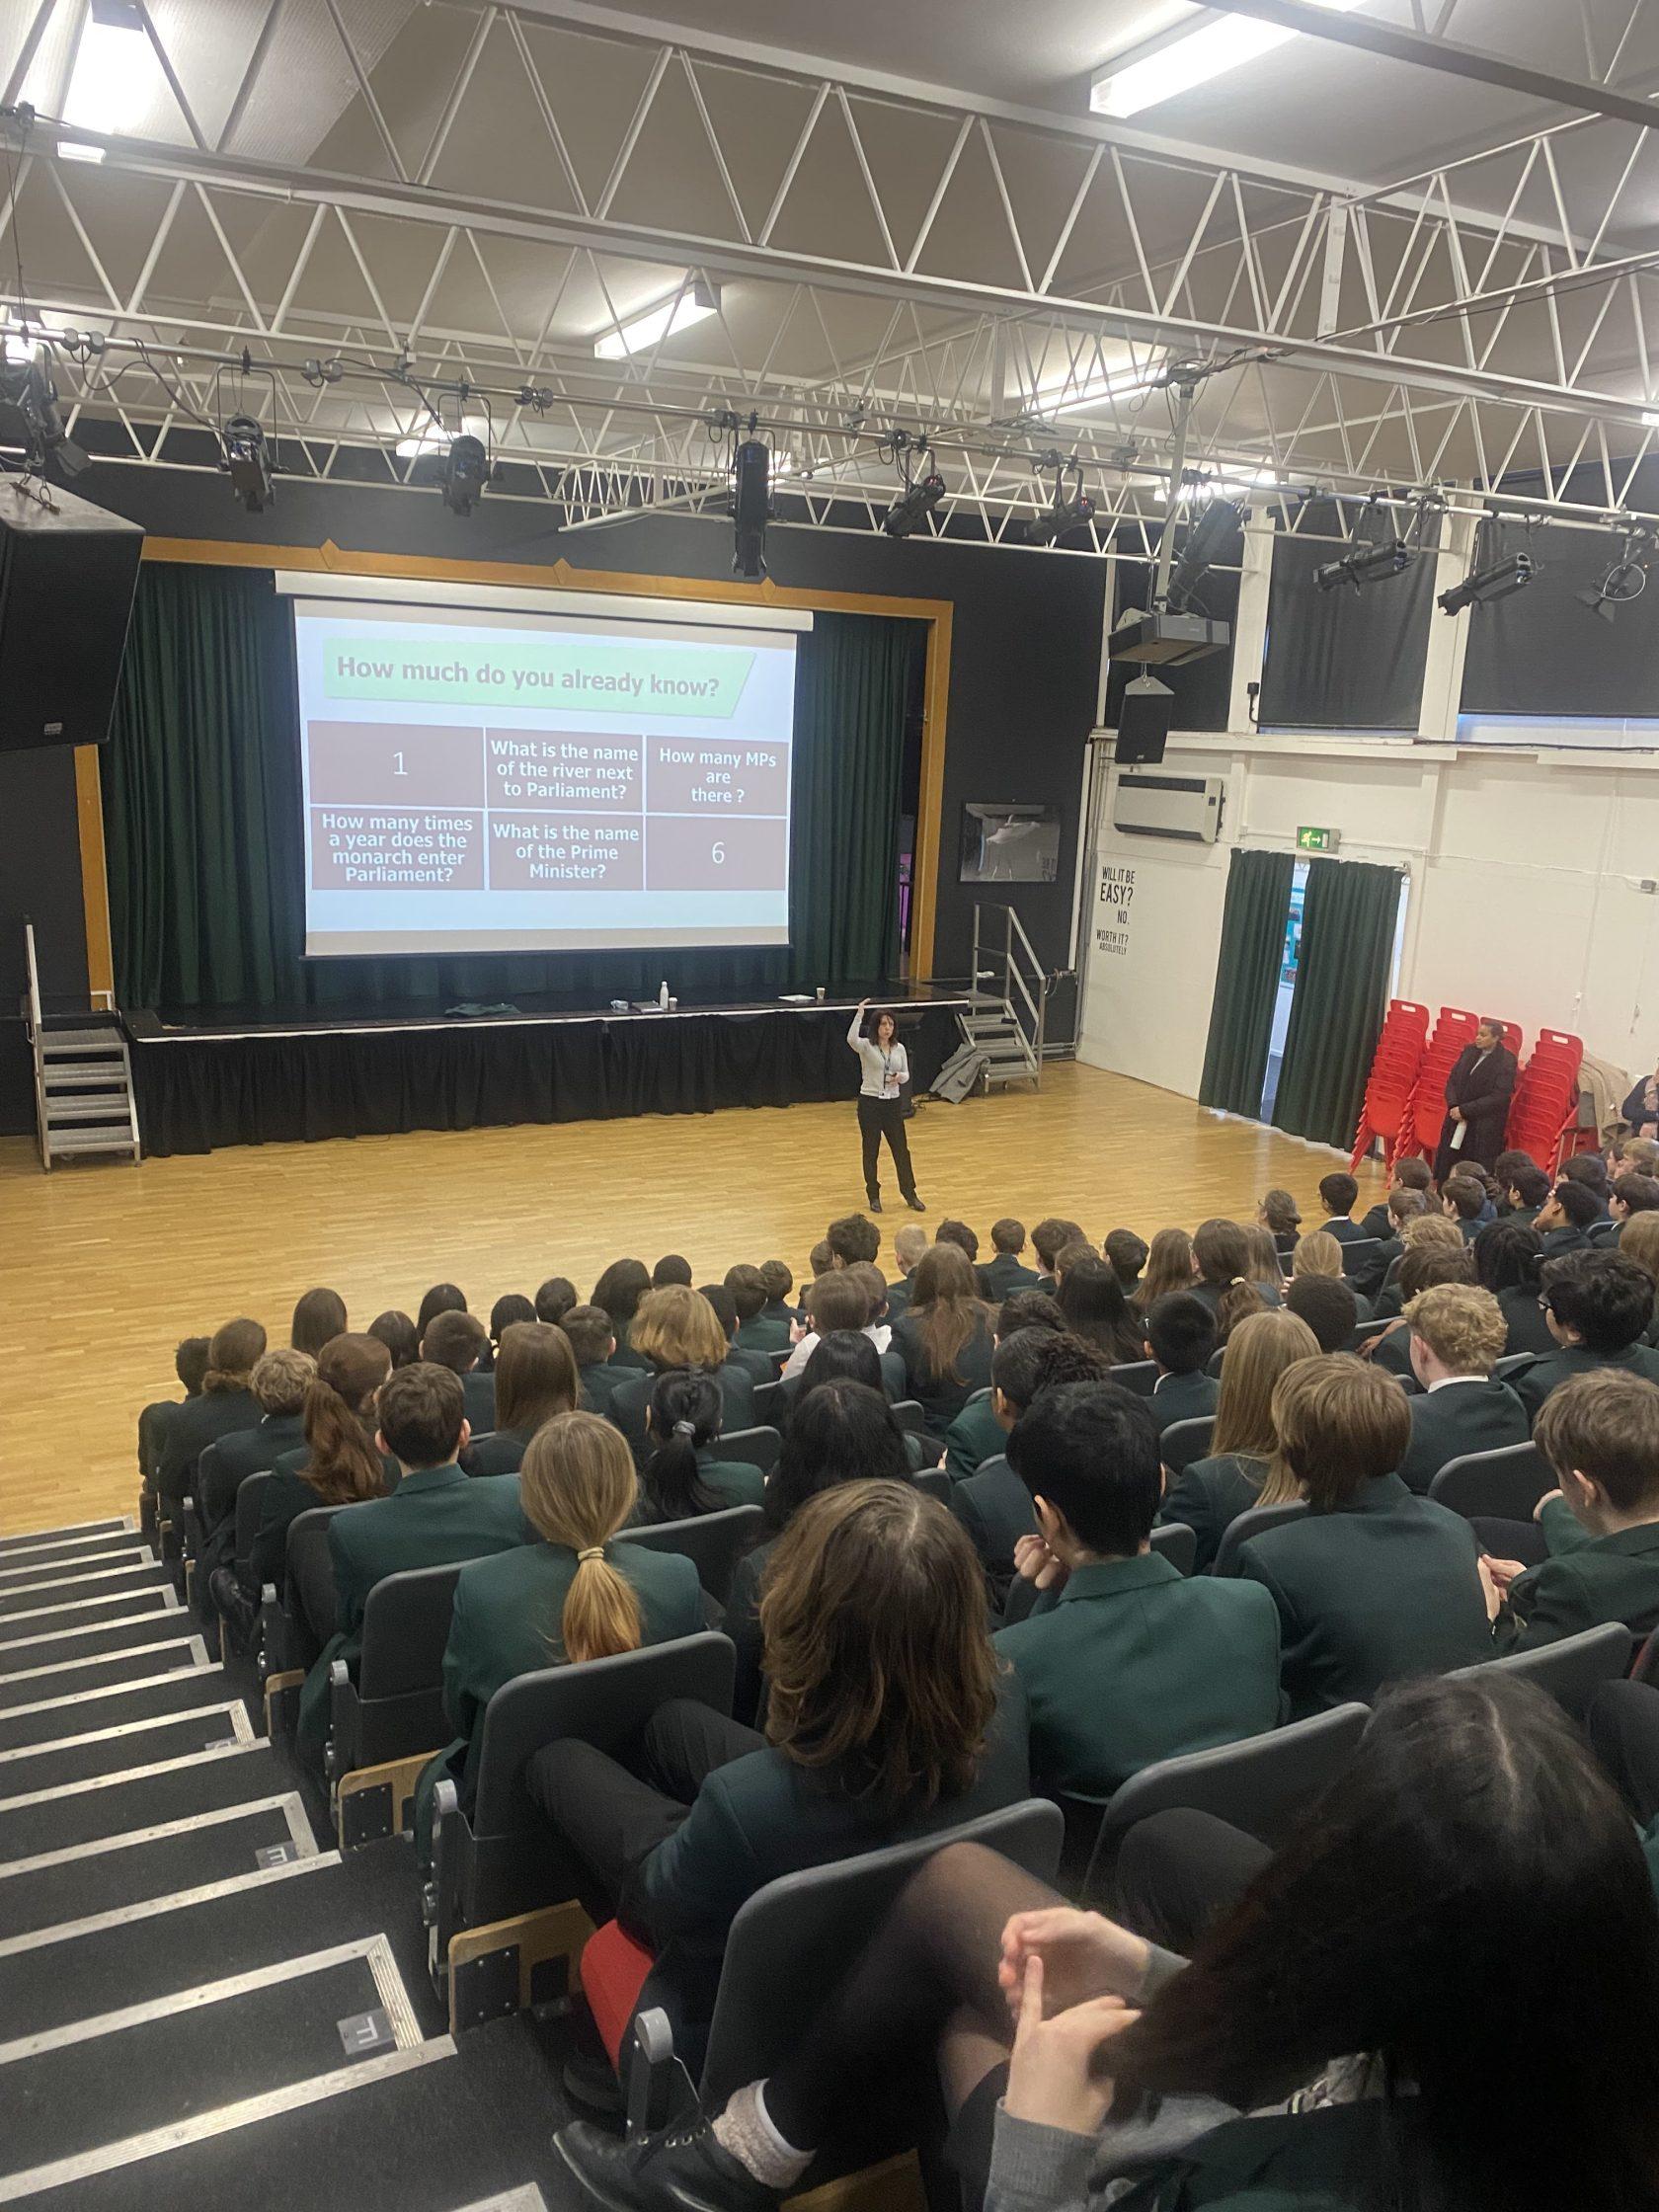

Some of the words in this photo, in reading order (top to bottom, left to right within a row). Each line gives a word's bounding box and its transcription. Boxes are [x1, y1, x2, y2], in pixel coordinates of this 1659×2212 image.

[338, 656, 394, 678] How
[402, 662, 469, 682] much
[476, 664, 506, 684] do
[512, 670, 554, 690] you
[561, 669, 644, 697] already
[650, 673, 720, 697] know?
[490, 740, 538, 757] What
[542, 742, 556, 758] is
[560, 743, 589, 759] the
[593, 747, 639, 761] name
[660, 748, 695, 764] How
[699, 751, 742, 769] many
[746, 751, 777, 767] MPs
[393, 751, 408, 776] 1
[497, 760, 515, 776] of
[519, 761, 548, 777] the
[552, 763, 592, 779] river
[596, 766, 634, 780] next
[706, 771, 731, 784] are
[504, 780, 521, 796] to
[526, 782, 627, 800] Parliament?
[691, 787, 733, 803] there
[322, 813, 364, 830] How
[369, 816, 419, 833] many
[425, 815, 473, 831] times
[493, 823, 540, 839] What
[544, 825, 558, 839] is
[562, 825, 591, 840] the
[594, 828, 640, 841] name
[329, 833, 341, 847] a
[345, 833, 386, 850] year
[391, 831, 434, 848] does
[437, 832, 467, 848] the
[332, 849, 413, 865] monarch
[418, 850, 466, 865] enter
[515, 843, 534, 859] of
[538, 843, 566, 859] the
[571, 844, 619, 860] Prime
[711, 840, 726, 865] 6
[346, 866, 453, 882] Parliament?
[529, 863, 606, 879] Minister?
[1102, 865, 1117, 882] WILL
[1117, 868, 1126, 882] IT
[1126, 869, 1136, 885] BE
[1100, 882, 1134, 907] EASY?
[1117, 909, 1130, 925] NO.
[1096, 928, 1117, 942] WORTH
[1117, 932, 1129, 946] IT?
[356, 2015, 378, 2045] F
